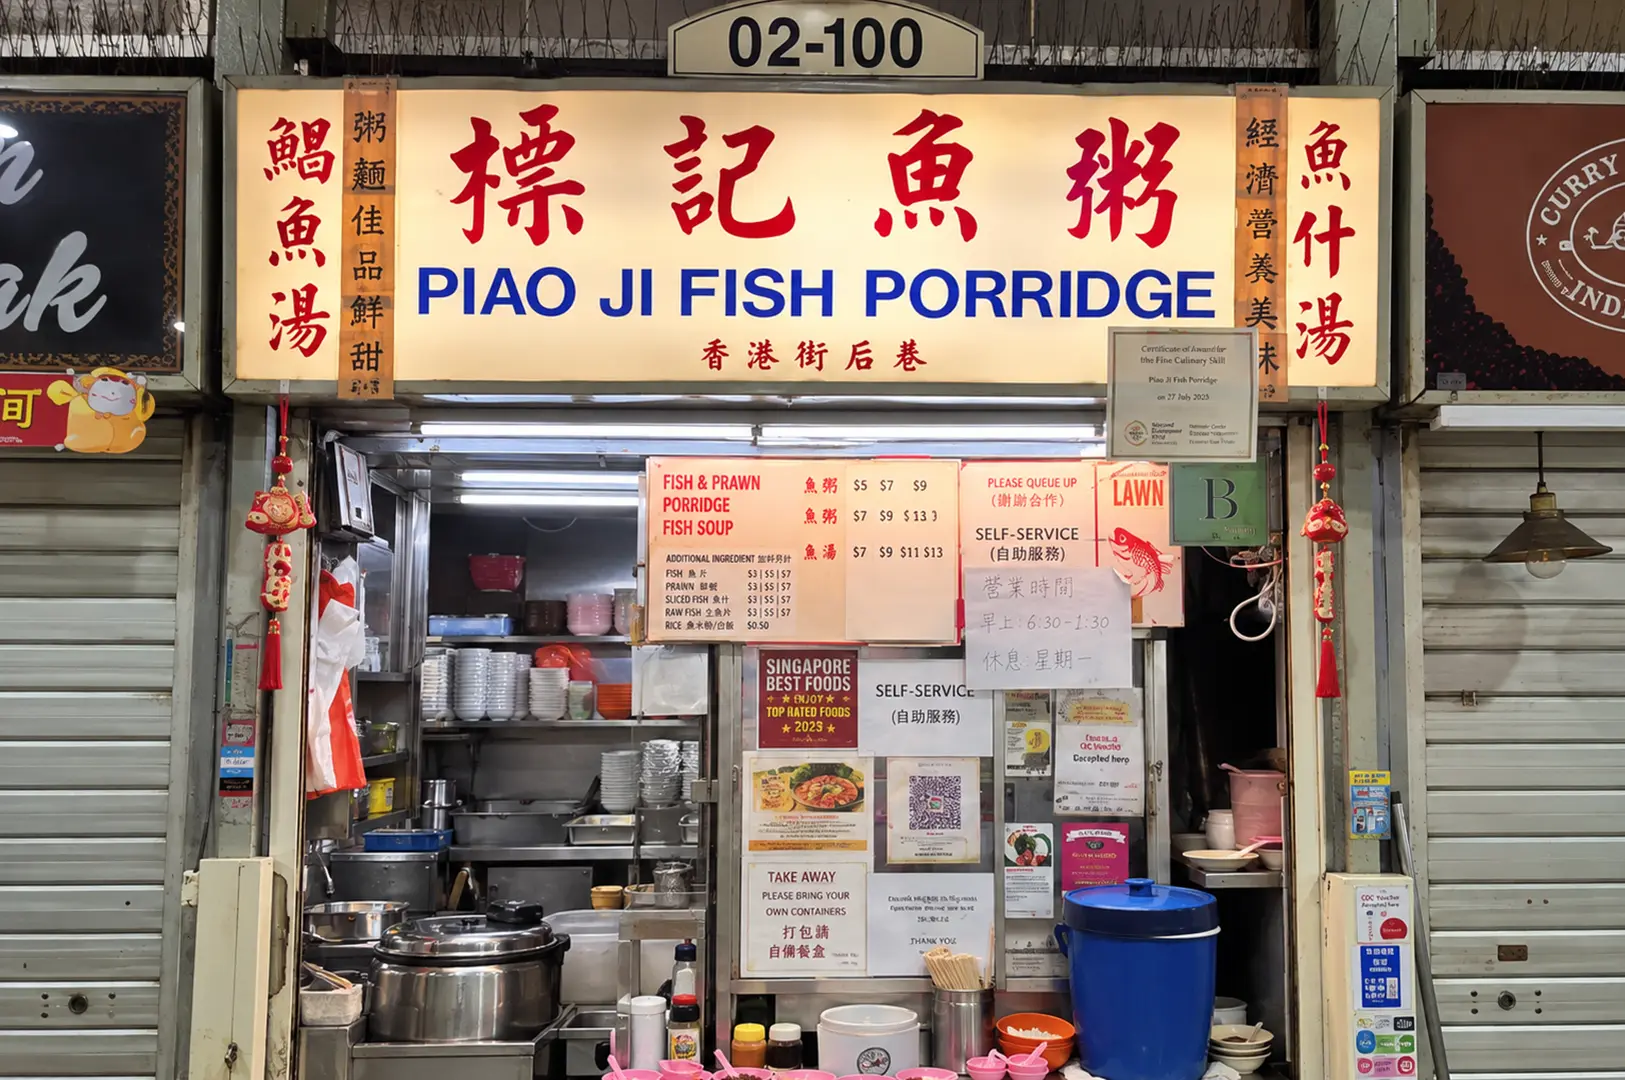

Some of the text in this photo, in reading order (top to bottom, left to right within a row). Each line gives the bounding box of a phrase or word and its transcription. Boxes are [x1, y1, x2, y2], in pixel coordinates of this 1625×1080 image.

[728, 16, 923, 69] 02-100
[450, 104, 1181, 248] 標記魚粥
[1540, 153, 1619, 226] CURRY
[263, 117, 336, 358] 鯧魚湯
[1293, 121, 1356, 366] 魚什湯
[418, 266, 1216, 320] PIAO JI FISH PORRIDGE
[701, 338, 928, 372] 香港街后巷
[663, 474, 761, 491] FISH & PRAWN
[804, 476, 927, 494] 魚粥 $5 $7 $9
[988, 478, 1078, 489] PLEASE QUEUE UP
[1113, 479, 1164, 506] LAWN
[1203, 478, 1239, 520] B
[663, 497, 730, 513] PORRIDGE
[804, 507, 838, 525] 魚粥
[853, 509, 867, 522] $7
[880, 509, 894, 522] $9
[663, 520, 734, 536] FISH SOUP
[976, 527, 1080, 541] SELF-SERVICE
[666, 554, 710, 564] ADDITIONAL
[712, 554, 755, 564] INGREDIENT
[804, 543, 944, 561] 魚湯 $7 $9 $11 $13
[990, 546, 1066, 562] (自助服務)
[665, 569, 683, 578] FISH
[747, 569, 758, 579] $3
[781, 569, 792, 579] $7
[747, 582, 758, 592] $3
[781, 582, 792, 592] $7
[665, 595, 691, 604] SLICED
[692, 595, 709, 604] FISH
[747, 595, 758, 604] $3
[781, 595, 792, 604] $7
[665, 608, 683, 617] RAW
[685, 608, 702, 617] FISH
[747, 608, 758, 617] $3
[781, 608, 792, 617] $7
[665, 621, 682, 630] RICE
[747, 621, 769, 630] $0.50
[766, 658, 851, 675] SINGAPORE
[766, 676, 851, 692] BEST FOODS
[793, 694, 824, 704] ENJOY
[766, 706, 785, 718] TOP
[820, 706, 851, 718] FOODS
[891, 709, 961, 726] (自助服務)
[768, 871, 836, 883] TAKE AWAY
[762, 891, 850, 900] PLEASE BRING YOUR
[766, 907, 847, 916] OWN CONTAINERS
